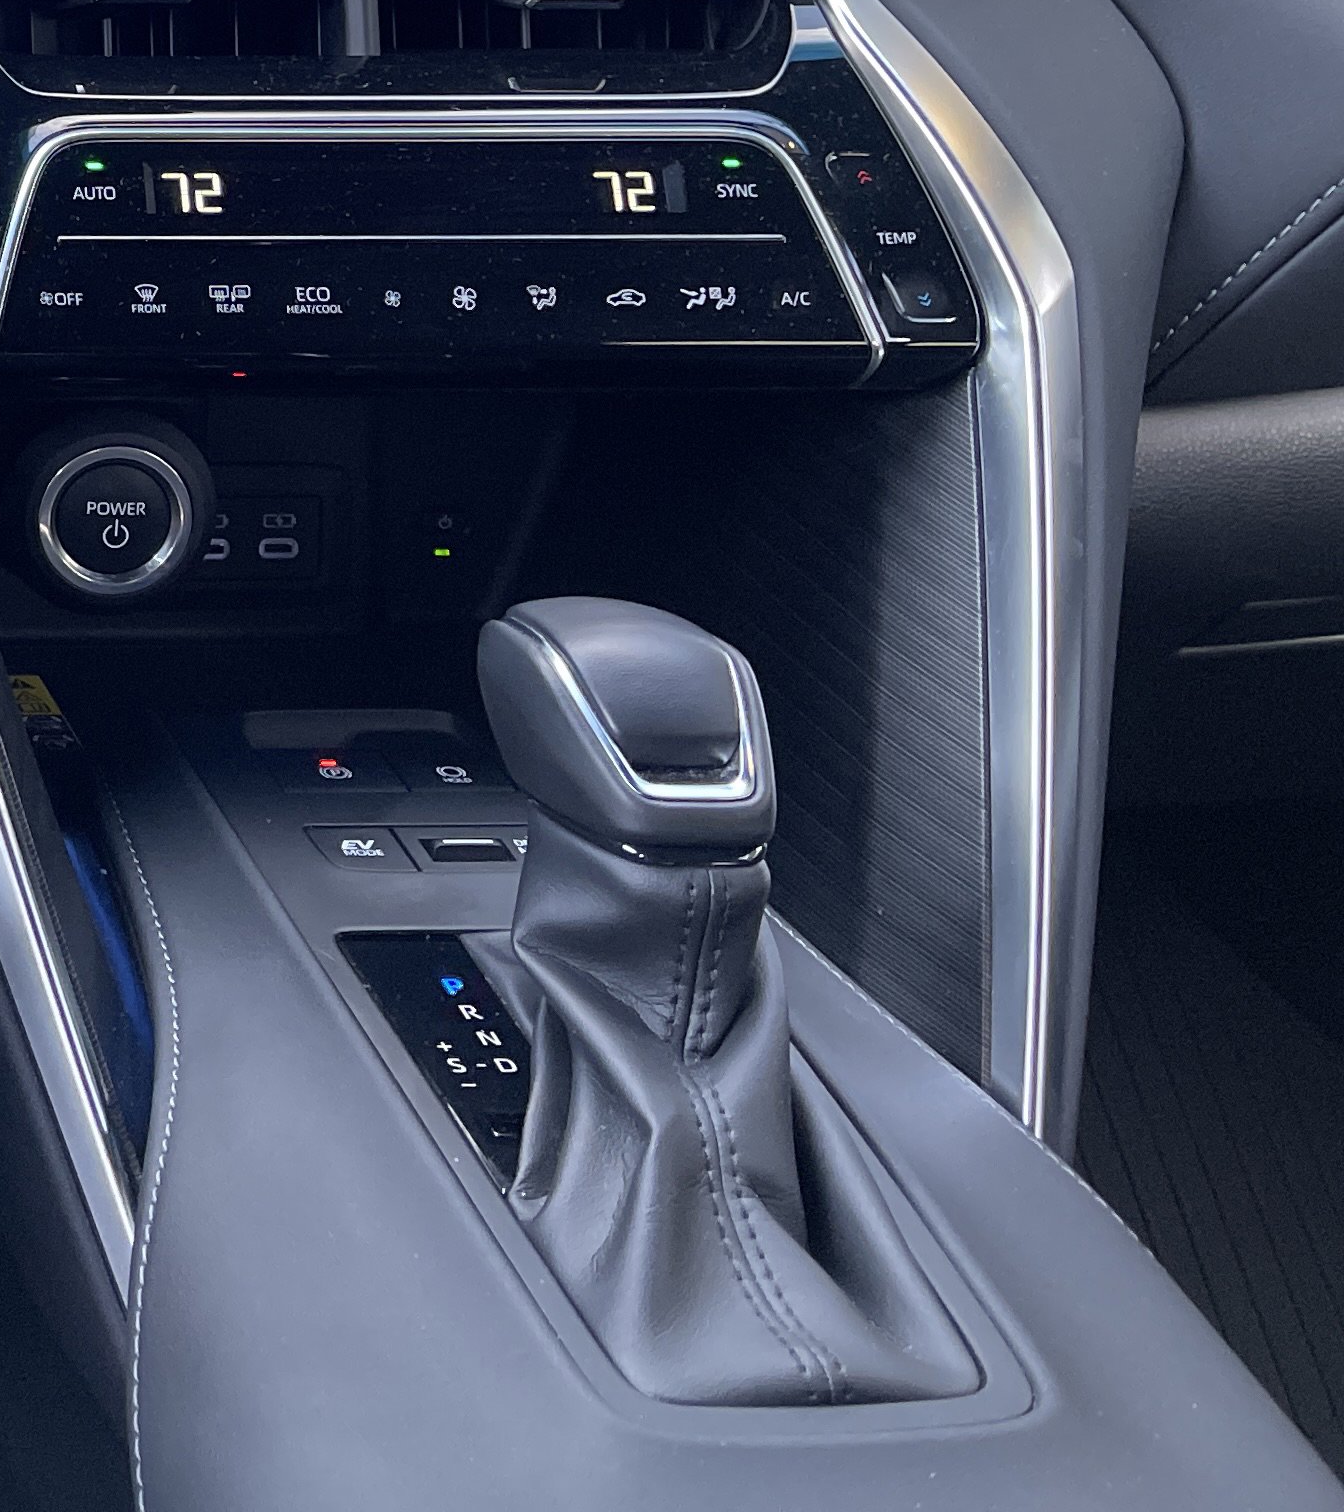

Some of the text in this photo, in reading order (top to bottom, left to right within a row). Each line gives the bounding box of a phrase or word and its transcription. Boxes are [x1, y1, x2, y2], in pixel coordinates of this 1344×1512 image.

[73, 186, 116, 200] AUTO
[161, 172, 223, 214] 72
[592, 171, 656, 213] 72
[717, 184, 758, 197] SYNC
[876, 232, 916, 244] TEMP
[55, 293, 83, 305] OFF
[295, 287, 330, 301] ECO
[781, 291, 811, 307] A/C
[131, 303, 167, 314] FRONT
[216, 303, 244, 313] REAR
[287, 304, 343, 314] HEAT/COOL
[87, 501, 145, 515] POWER
[341, 839, 375, 849] EV
[343, 849, 385, 857] MODE
[441, 977, 464, 996] P
[458, 1005, 483, 1019] R
[475, 1030, 502, 1046] N
[447, 1058, 466, 1073] S
[494, 1058, 517, 1072] D
